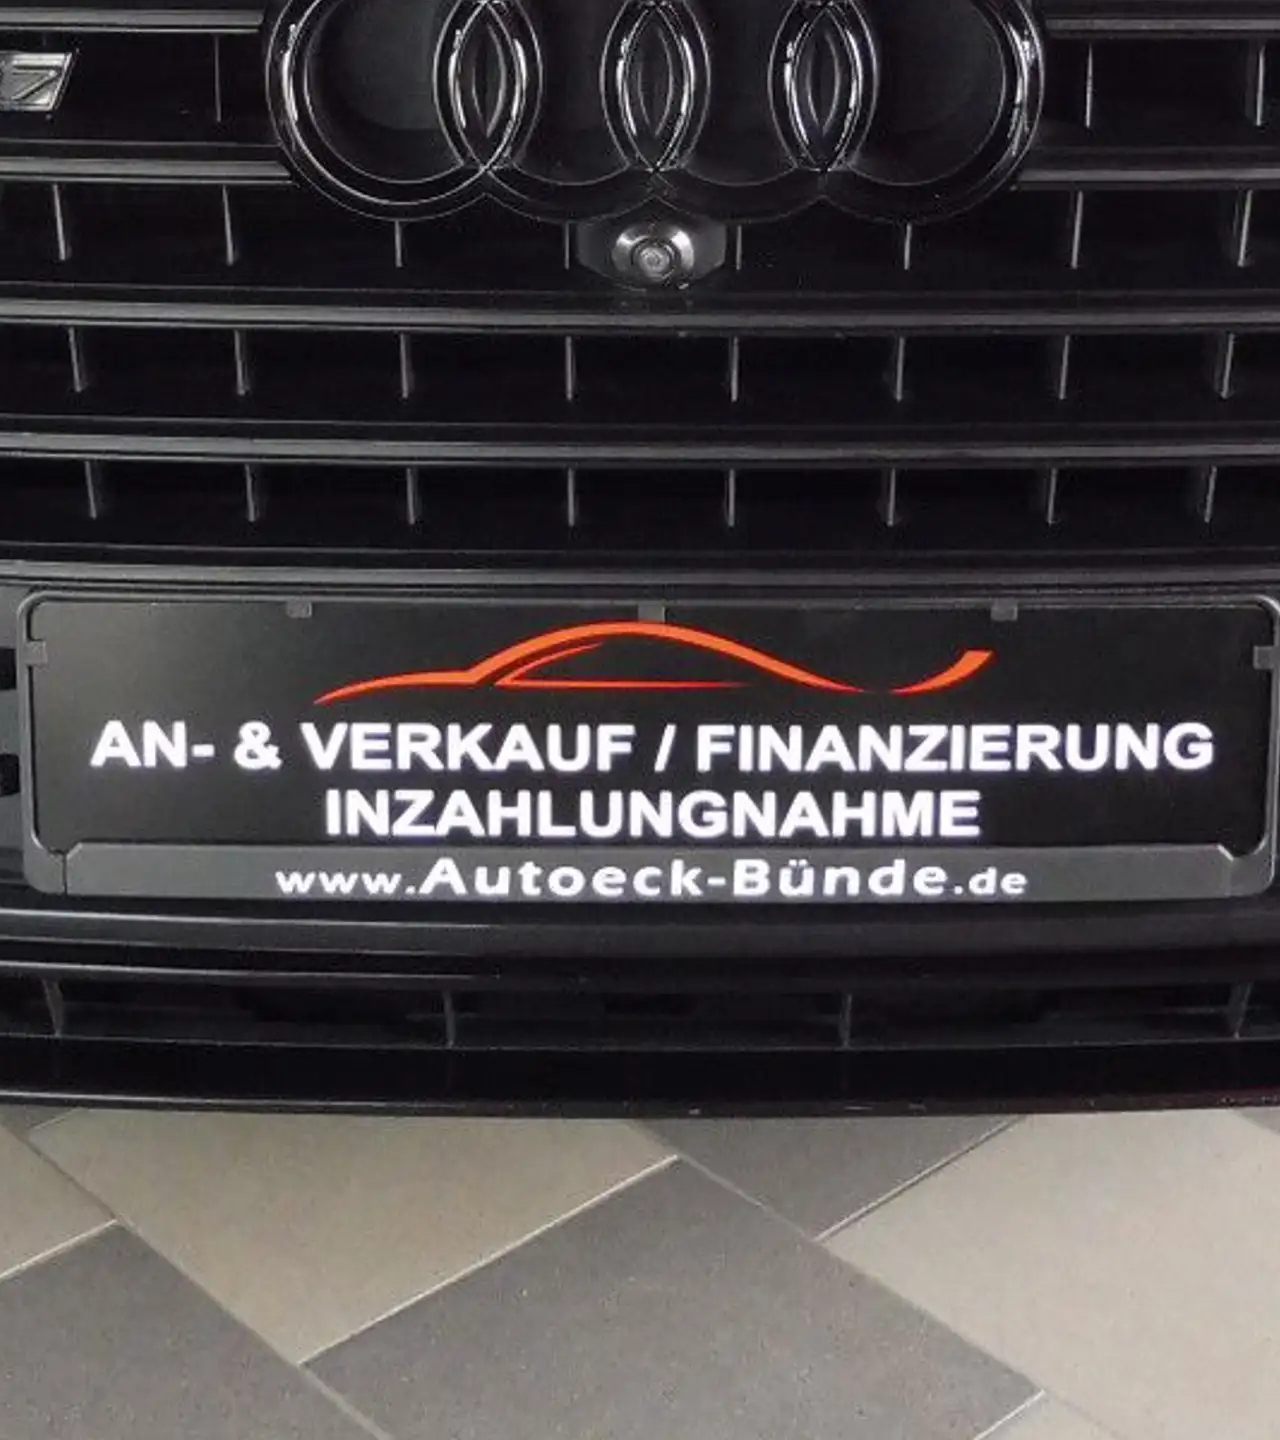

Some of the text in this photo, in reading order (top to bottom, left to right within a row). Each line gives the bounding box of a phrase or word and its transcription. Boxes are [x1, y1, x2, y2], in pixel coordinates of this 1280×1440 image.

[89, 720, 1214, 773] AN- & VERKAUF / FINANZIERUNG
[325, 788, 981, 839] INZAHLUNGNAHME
[274, 857, 1028, 899] www.Autoeck-Bünde.de
